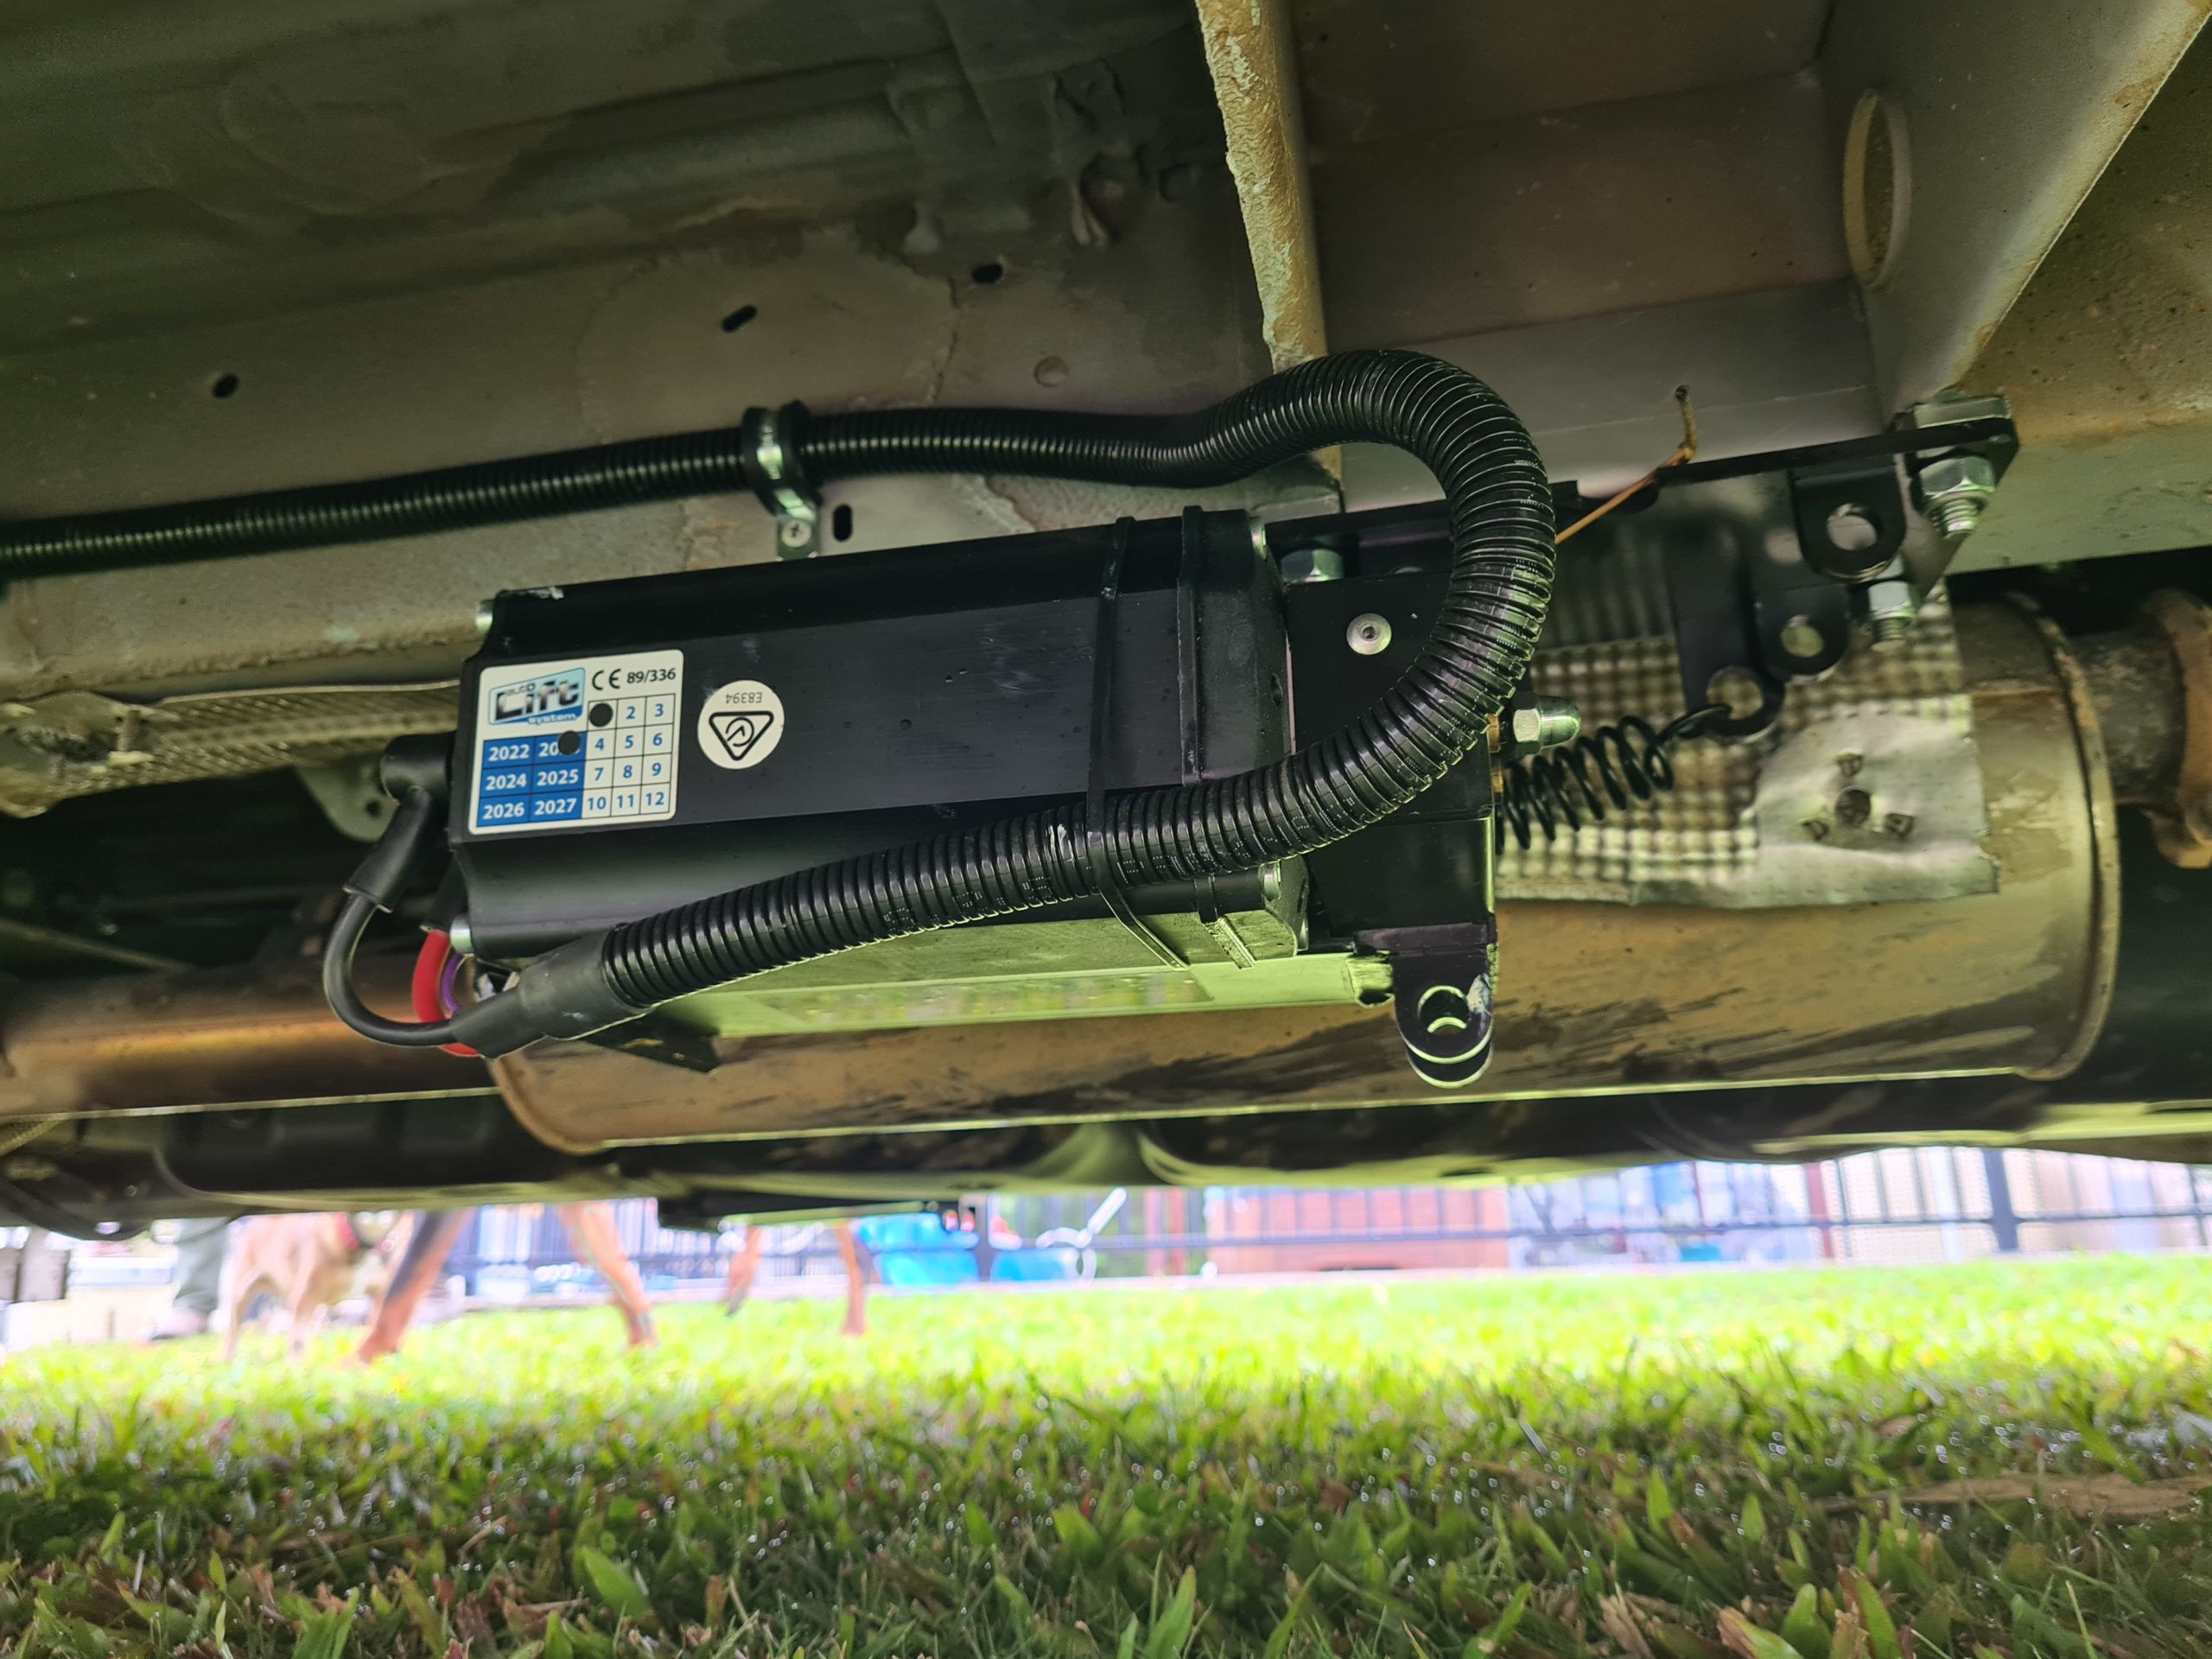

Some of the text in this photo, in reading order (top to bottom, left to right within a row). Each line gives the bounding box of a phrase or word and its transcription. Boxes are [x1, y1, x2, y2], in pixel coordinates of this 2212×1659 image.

[592, 667, 677, 690] CE 89/336
[726, 692, 762, 704] E8394
[528, 713, 576, 725] system
[626, 703, 664, 719] 2 3
[594, 733, 663, 751] 4 5 6
[488, 744, 530, 761] 2022
[485, 768, 579, 791] 2024 2025
[594, 762, 662, 781] 7 8 9
[482, 798, 577, 820] 2026 2027
[588, 791, 664, 810] 10 11 12
